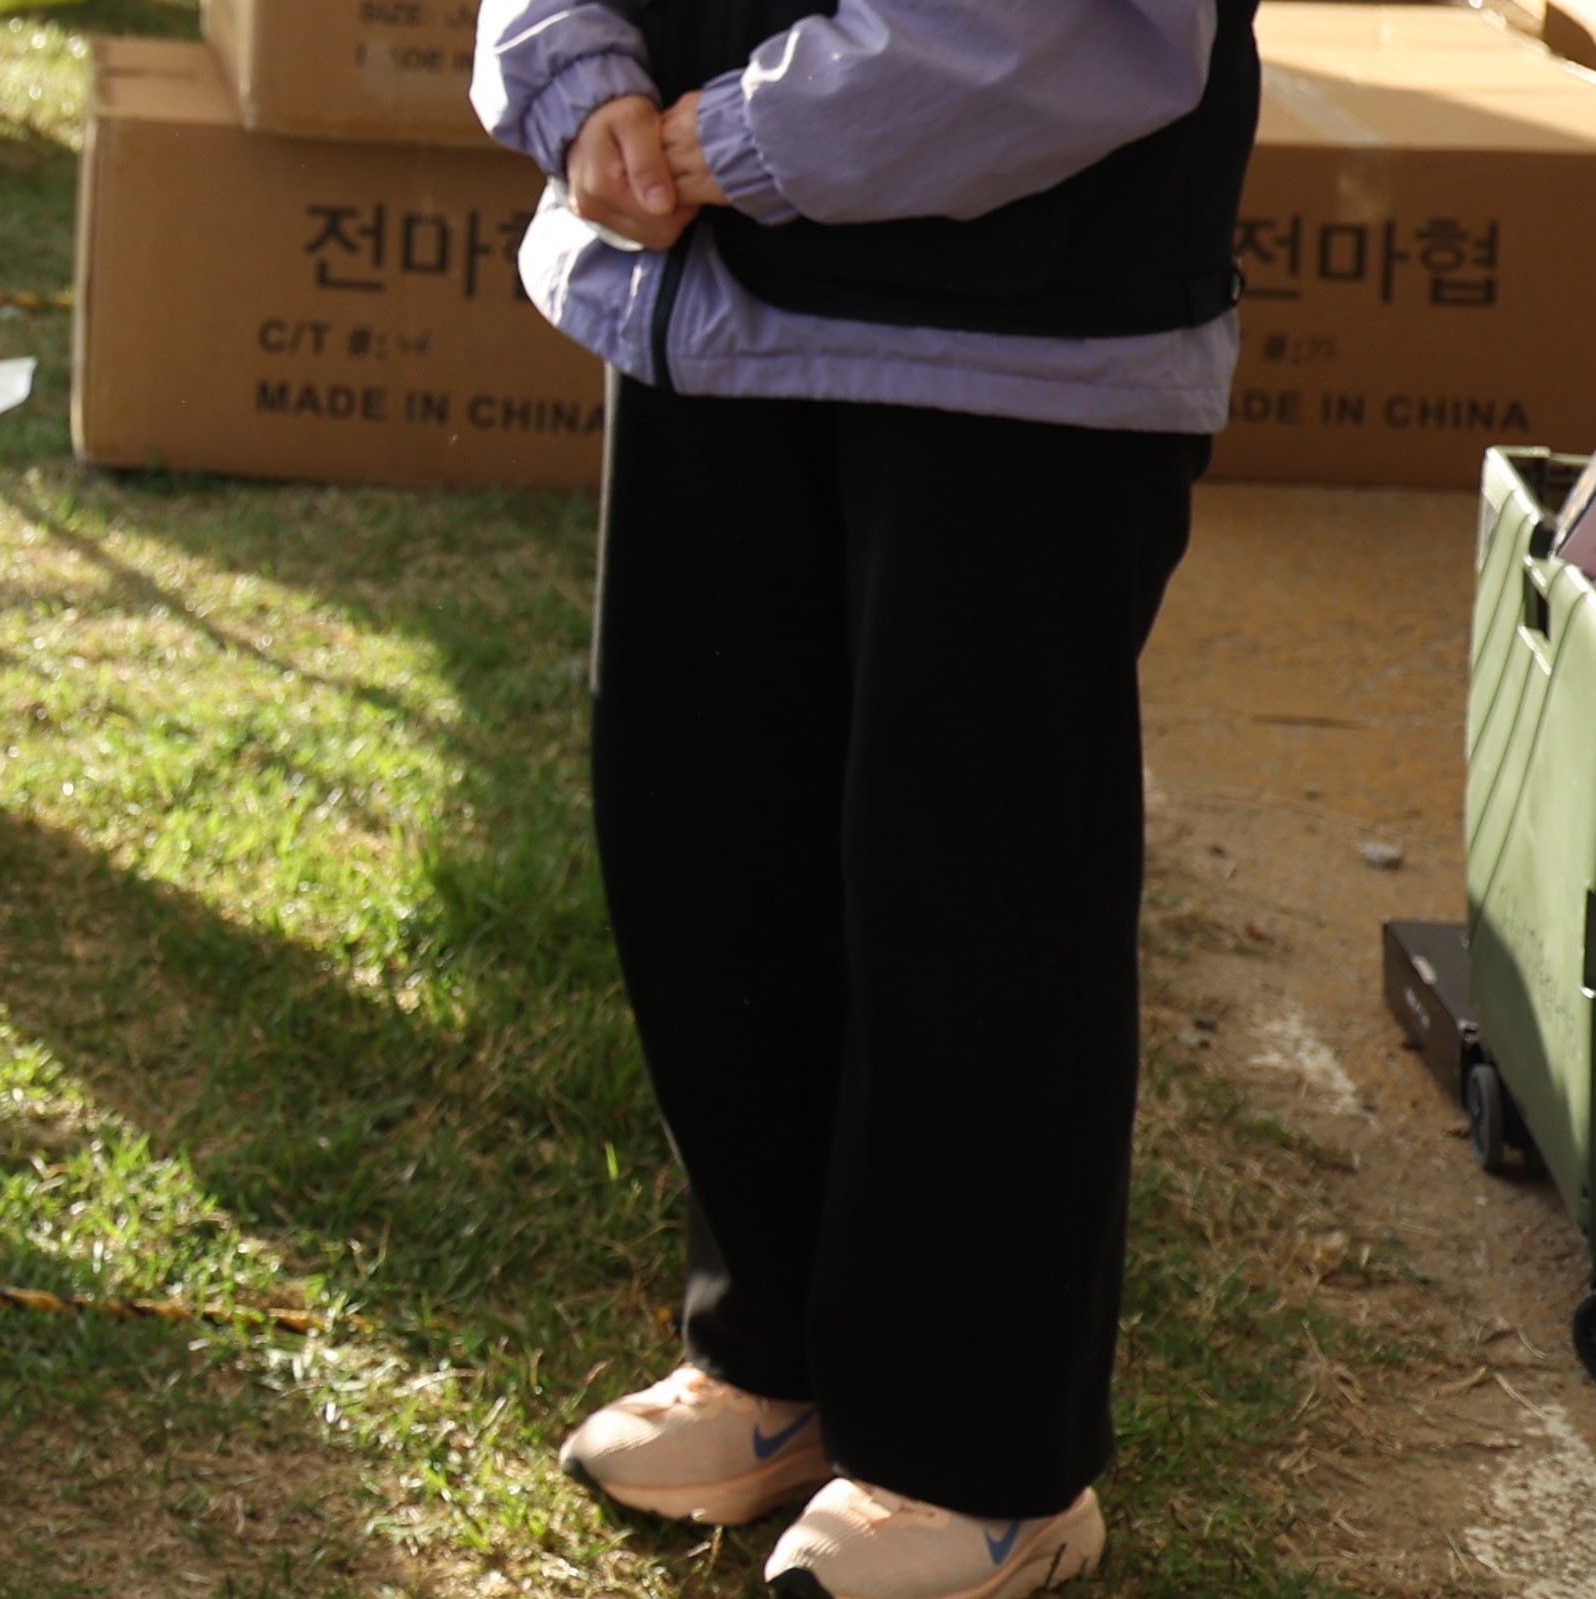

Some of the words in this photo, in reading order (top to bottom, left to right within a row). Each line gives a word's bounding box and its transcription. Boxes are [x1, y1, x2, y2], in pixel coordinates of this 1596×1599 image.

[1235, 214, 1500, 308] 전마협
[257, 317, 329, 355] C/T
[256, 377, 389, 423] MADE
[403, 387, 451, 427] IN
[466, 394, 604, 438] CHINA
[1321, 392, 1365, 428] IN
[1384, 394, 1530, 435] CHINA
